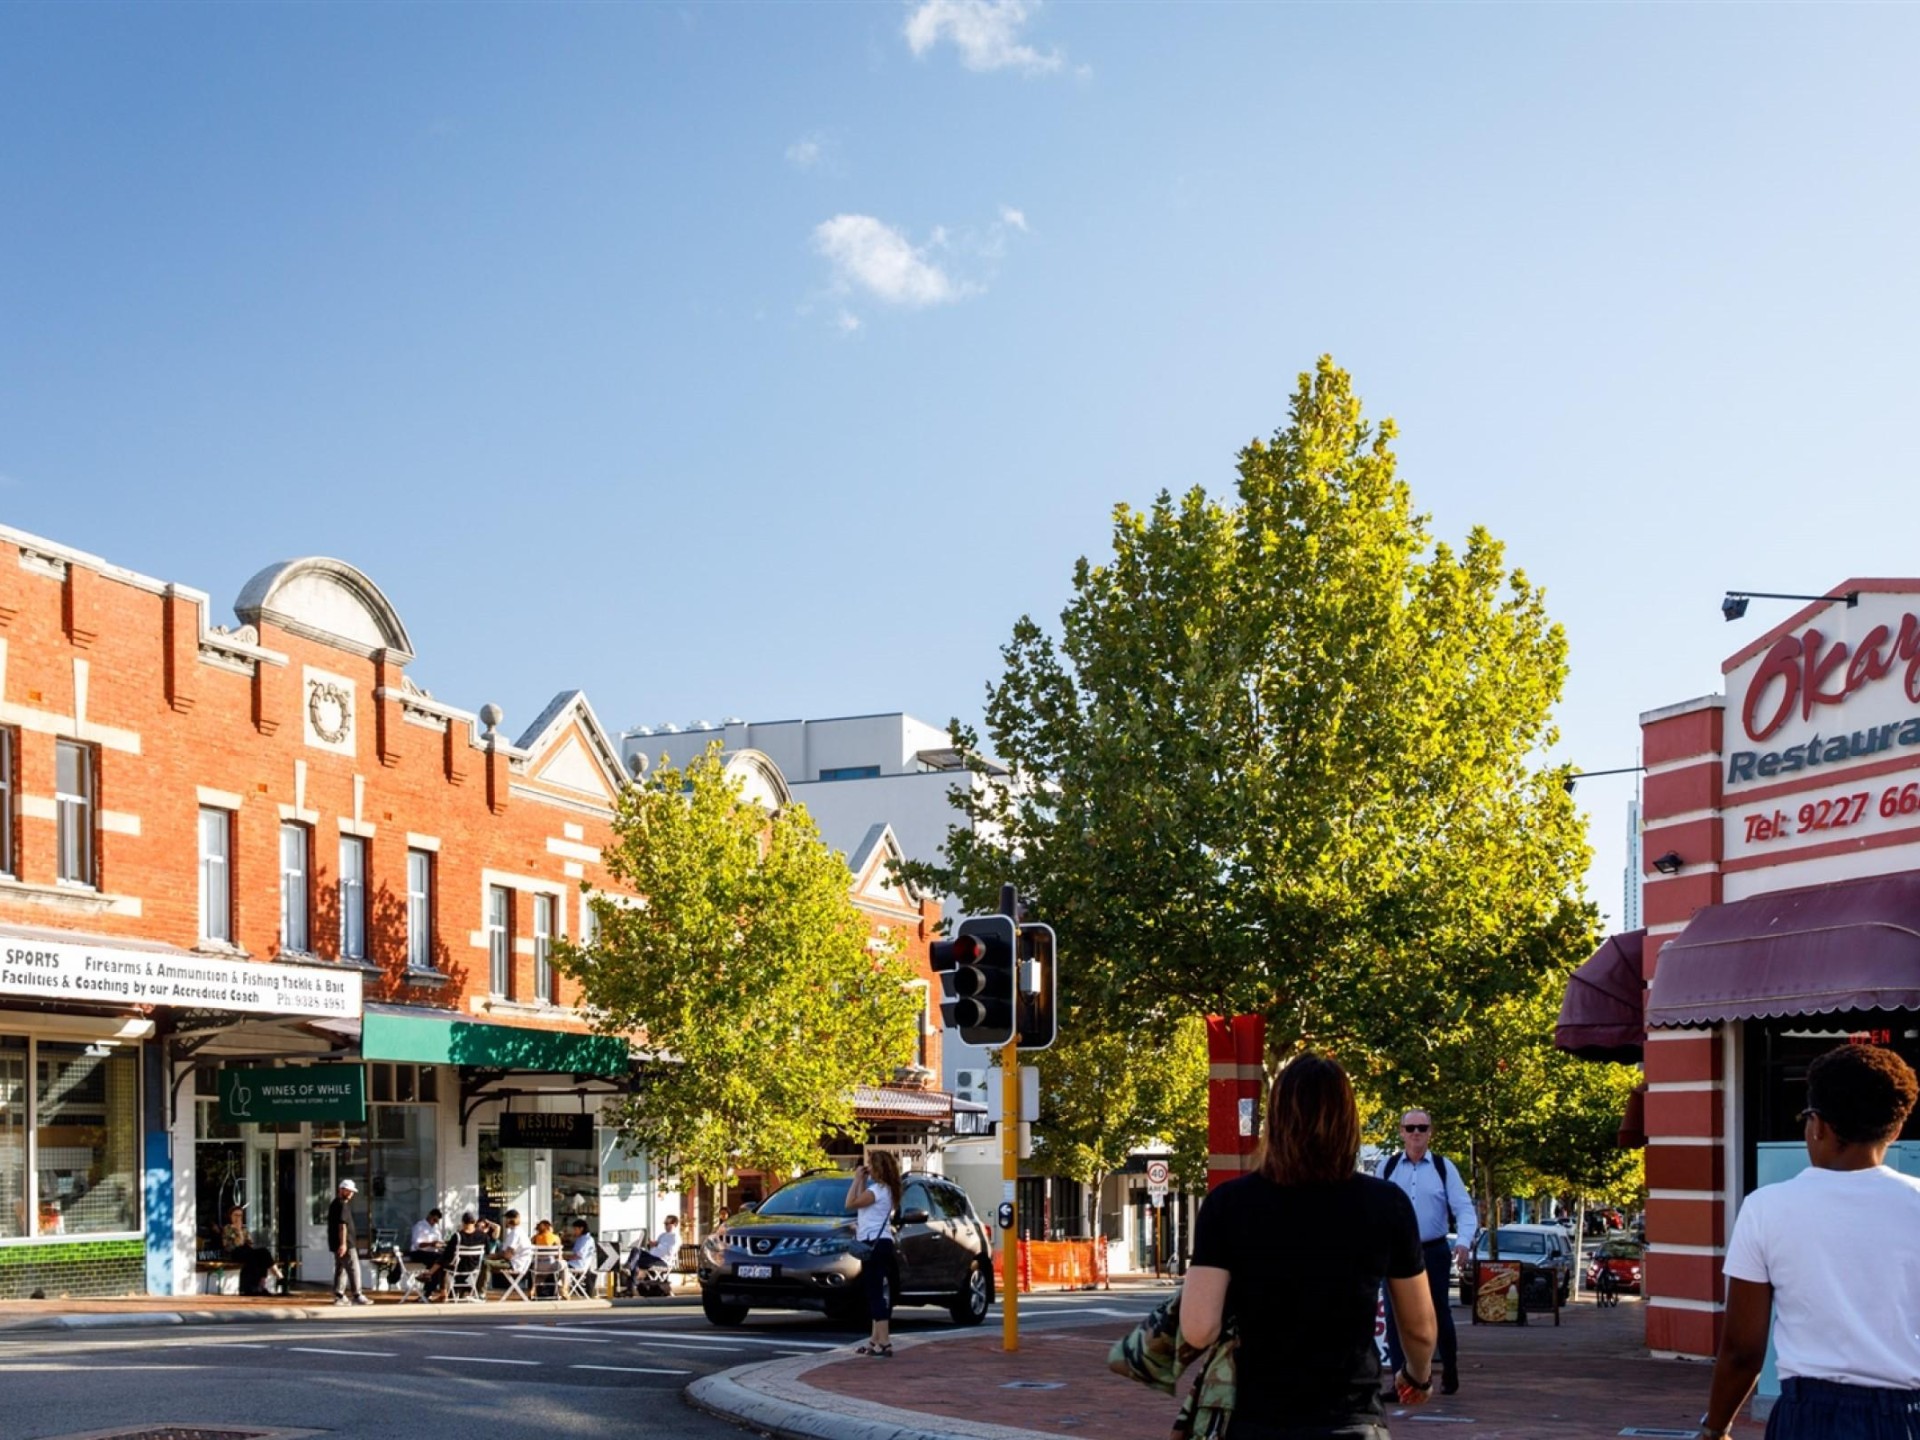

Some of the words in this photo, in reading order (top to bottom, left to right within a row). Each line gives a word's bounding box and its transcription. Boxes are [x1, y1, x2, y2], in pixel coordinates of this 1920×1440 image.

[1727, 716, 1920, 784] Restaura
[1744, 809, 1788, 843] Tel:
[1797, 792, 1869, 834] 9227
[1879, 782, 1920, 818] 66
[6, 948, 60, 969] SPORTS
[85, 956, 141, 975] Firearms
[145, 962, 153, 976] &
[157, 963, 228, 983] Ammunition
[231, 971, 239, 984] &
[243, 971, 279, 990] Fishing
[282, 975, 313, 991] Tackle
[316, 978, 322, 991] &
[325, 979, 344, 993] Bait
[2, 969, 59, 988] Facilities
[62, 974, 71, 988] &
[75, 976, 129, 995] Coaching
[134, 981, 146, 996] by
[150, 984, 169, 997] our
[172, 984, 227, 1001] Accredited
[230, 989, 259, 1004] Coach
[1850, 1029, 1890, 1045] OPEN
[261, 1084, 296, 1096] WINES
[298, 1084, 315, 1096] OF
[317, 1083, 352, 1095] WHILE
[517, 1113, 575, 1132] WESTONS
[1151, 1168, 1165, 1178] 40
